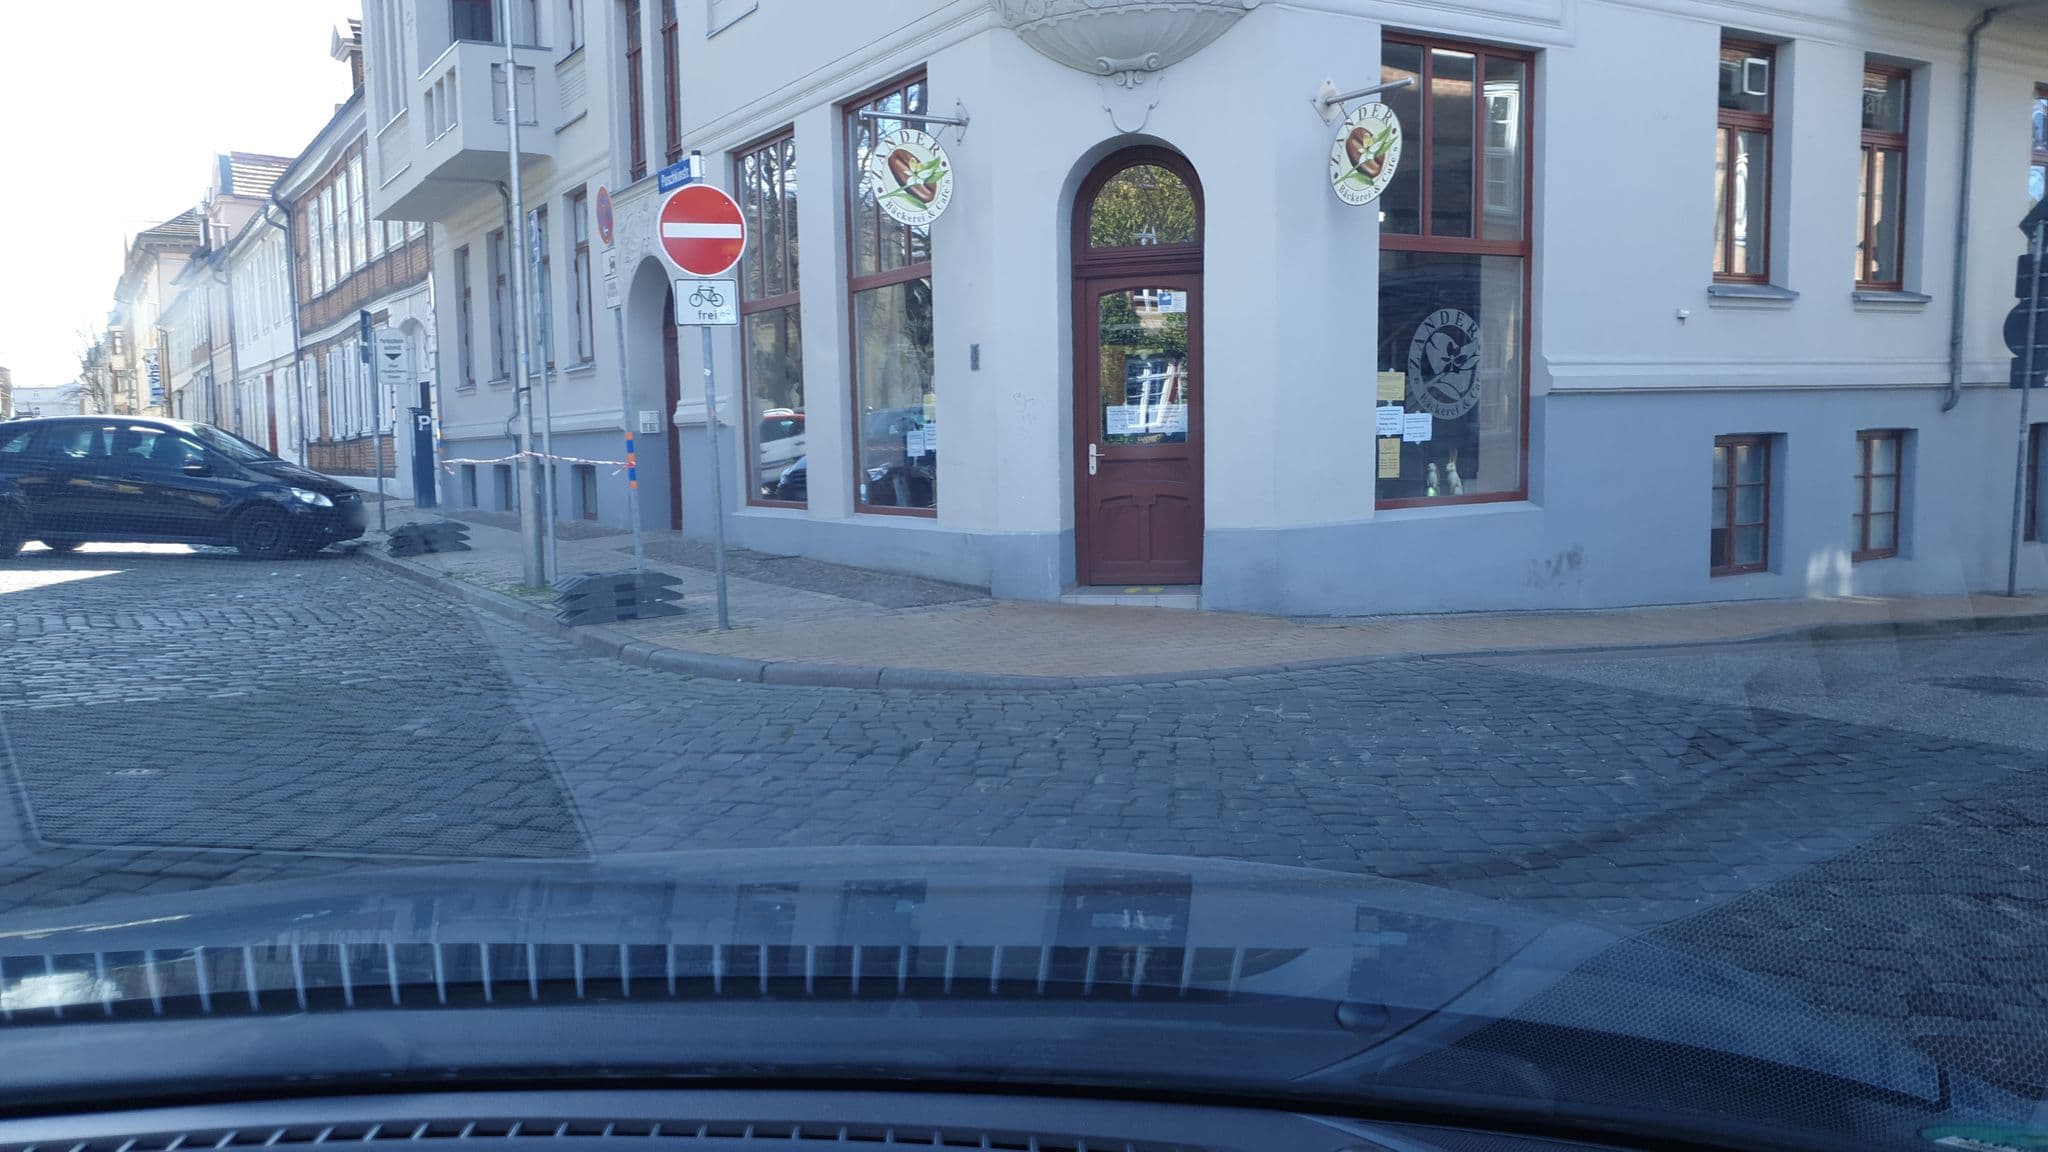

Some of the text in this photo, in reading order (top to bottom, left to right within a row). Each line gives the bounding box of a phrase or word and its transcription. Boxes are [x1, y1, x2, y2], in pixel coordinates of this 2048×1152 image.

[1330, 104, 1392, 166] ZANDER
[871, 131, 939, 180] ZANDER
[1339, 185, 1371, 202] Bäckerei
[885, 201, 925, 221] Bäckerei
[698, 310, 717, 320] frei
[1410, 311, 1478, 370] ZANDER
[418, 415, 431, 431] P
